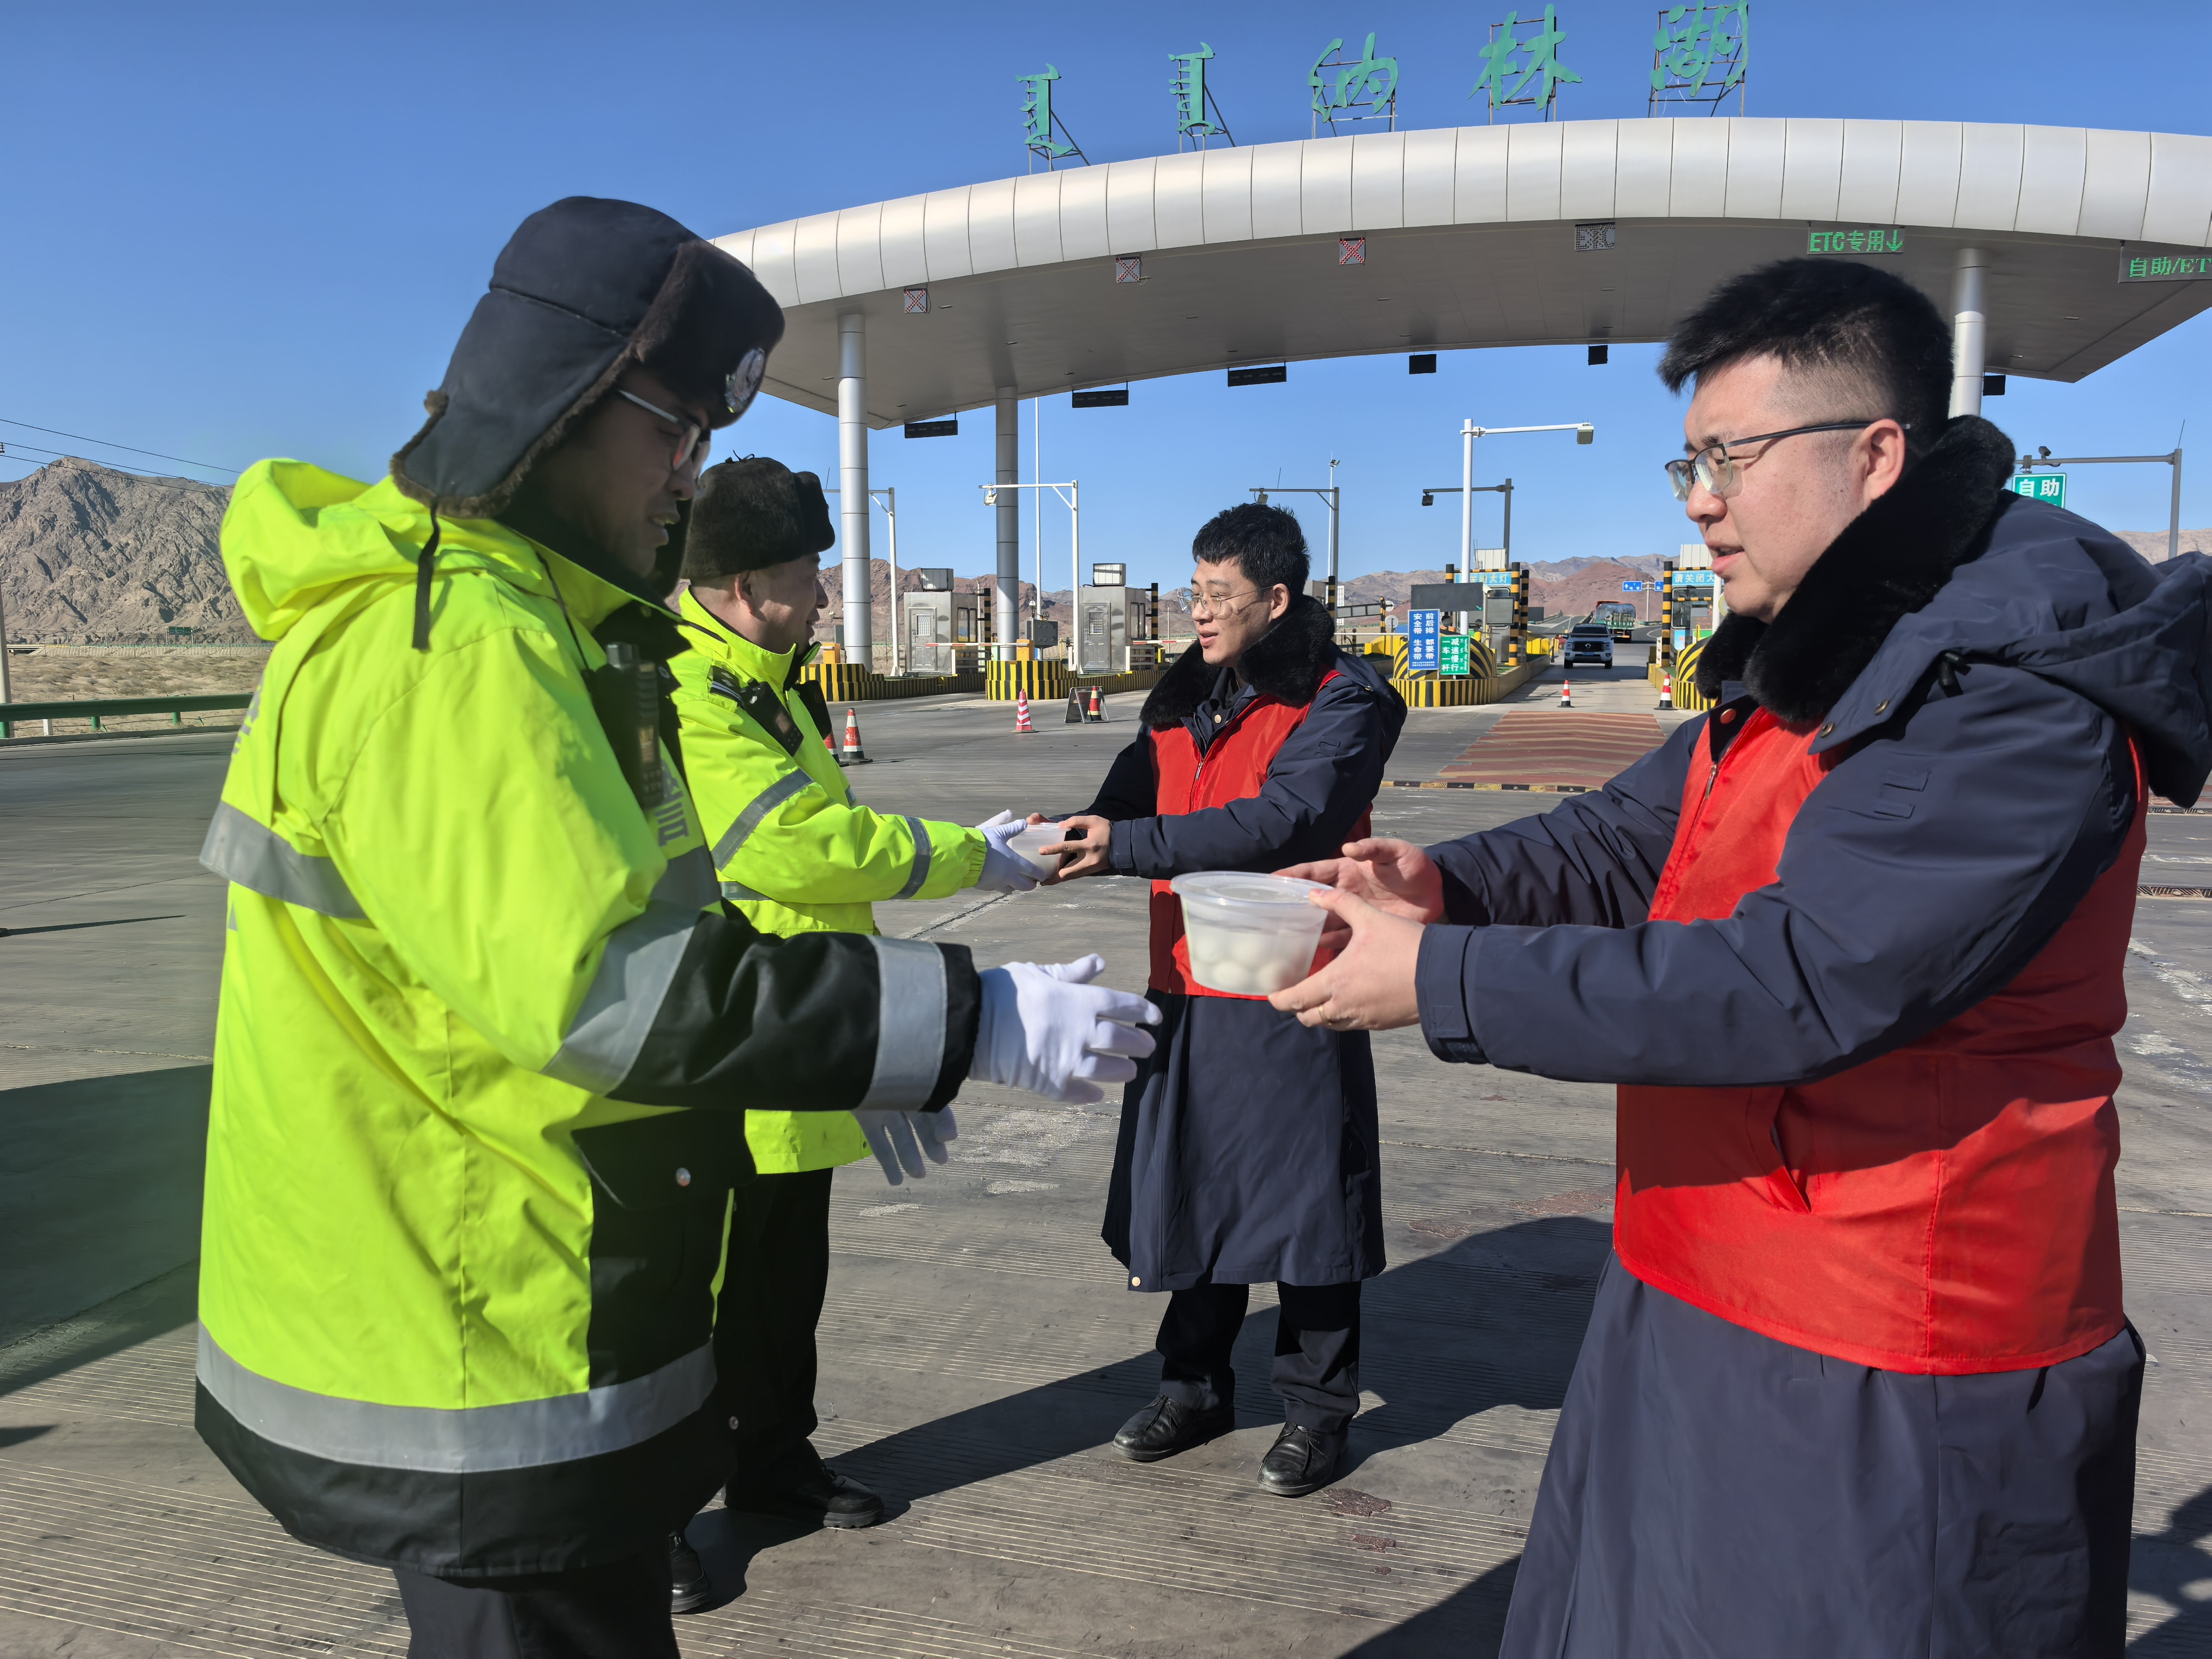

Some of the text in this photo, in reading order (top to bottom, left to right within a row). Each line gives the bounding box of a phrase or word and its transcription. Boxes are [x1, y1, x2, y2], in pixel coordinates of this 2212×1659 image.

[1308, 0, 1749, 123] 纳林湖
[1810, 230, 1884, 252] ETC专用
[2019, 478, 2060, 497] 自助
[1459, 574, 1508, 583] 关闭大灯
[1413, 613, 1422, 660] 安全带 生命带
[1425, 613, 1434, 634] 前后排
[1441, 640, 1451, 671] 一车一杆
[1451, 638, 1459, 671] 减速慢行
